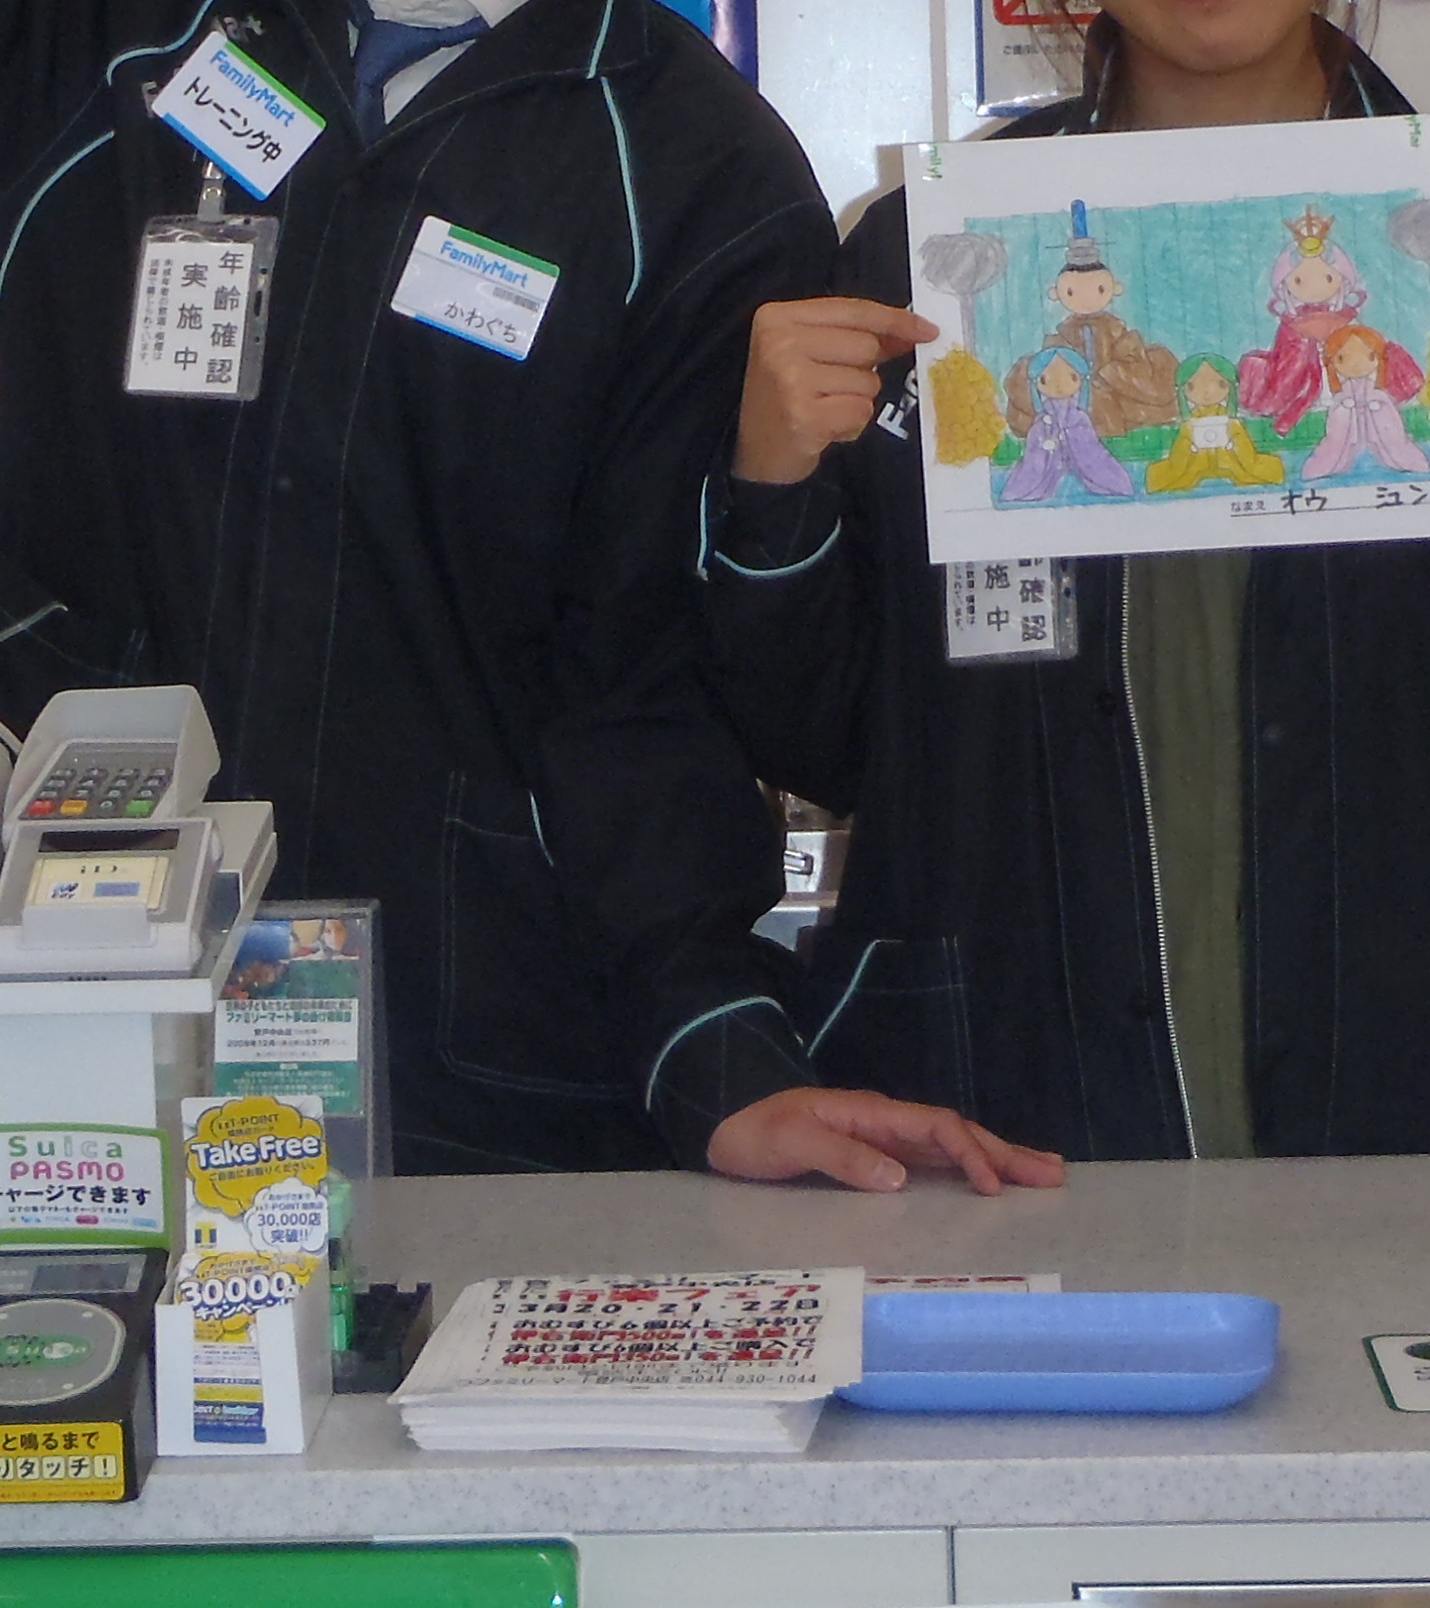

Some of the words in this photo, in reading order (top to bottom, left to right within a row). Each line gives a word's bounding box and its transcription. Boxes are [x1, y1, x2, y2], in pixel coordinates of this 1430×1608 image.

[210, 50, 295, 127] FamilyMart
[183, 75, 282, 164] トレーニング中
[439, 240, 528, 289] FamilyMart
[174, 263, 209, 371] 実施中
[206, 251, 244, 383] 年齢確認
[443, 301, 517, 344] かわぐち
[8, 1135, 123, 1159] Suica
[10, 1161, 125, 1182] PASMO
[191, 1140, 257, 1169] Take
[259, 1135, 319, 1160] Free
